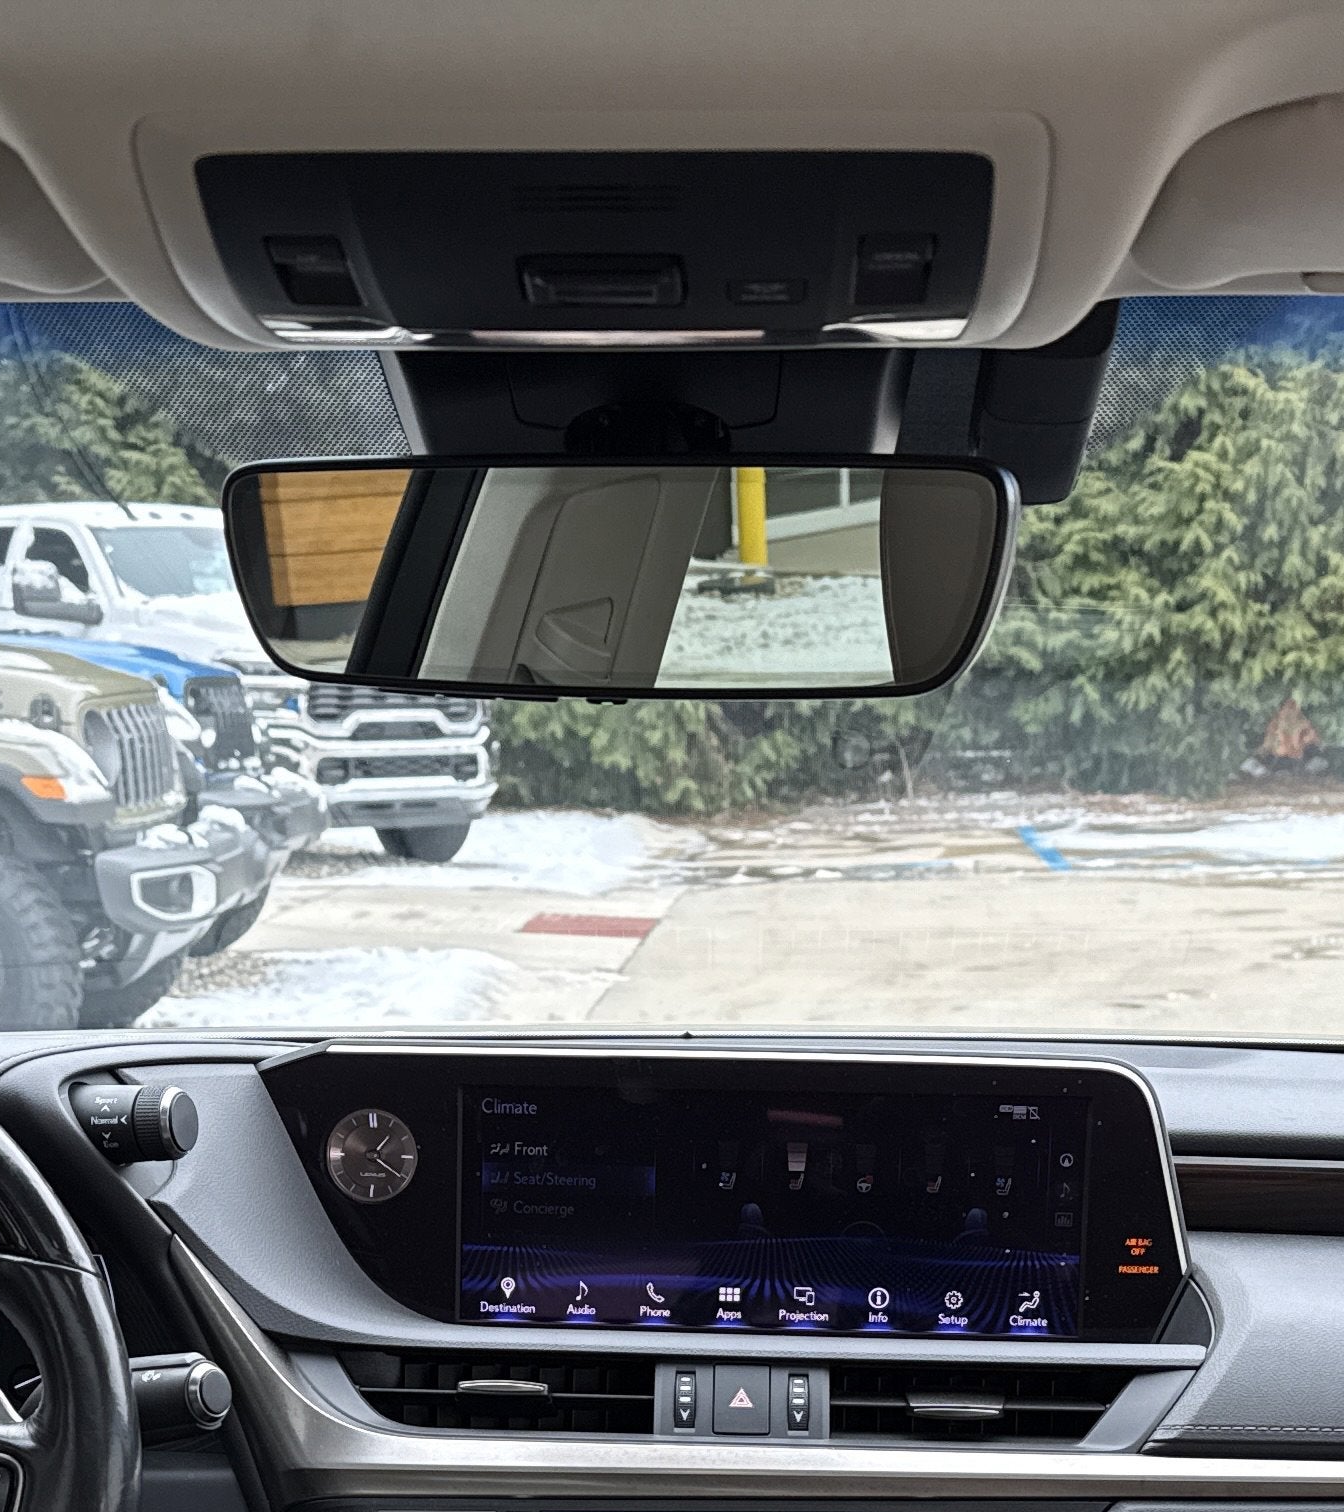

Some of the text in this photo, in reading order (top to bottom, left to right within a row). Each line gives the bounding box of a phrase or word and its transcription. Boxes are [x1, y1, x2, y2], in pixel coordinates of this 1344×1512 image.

[94, 1096, 118, 1105] Sport
[481, 1098, 538, 1116] Climate
[90, 1115, 119, 1125] Normal
[514, 1142, 548, 1156] Front
[513, 1171, 597, 1189] Seat/Steering
[513, 1202, 575, 1216] Concierge
[1118, 1265, 1160, 1274] PASSENGER
[480, 1301, 536, 1314] Destination
[566, 1303, 596, 1316] Audio
[639, 1305, 671, 1318] Phone
[716, 1307, 742, 1321] Apps
[778, 1309, 829, 1323] Projection
[868, 1311, 888, 1323] Info
[938, 1313, 969, 1327] Setup
[1009, 1315, 1049, 1327] Climate
